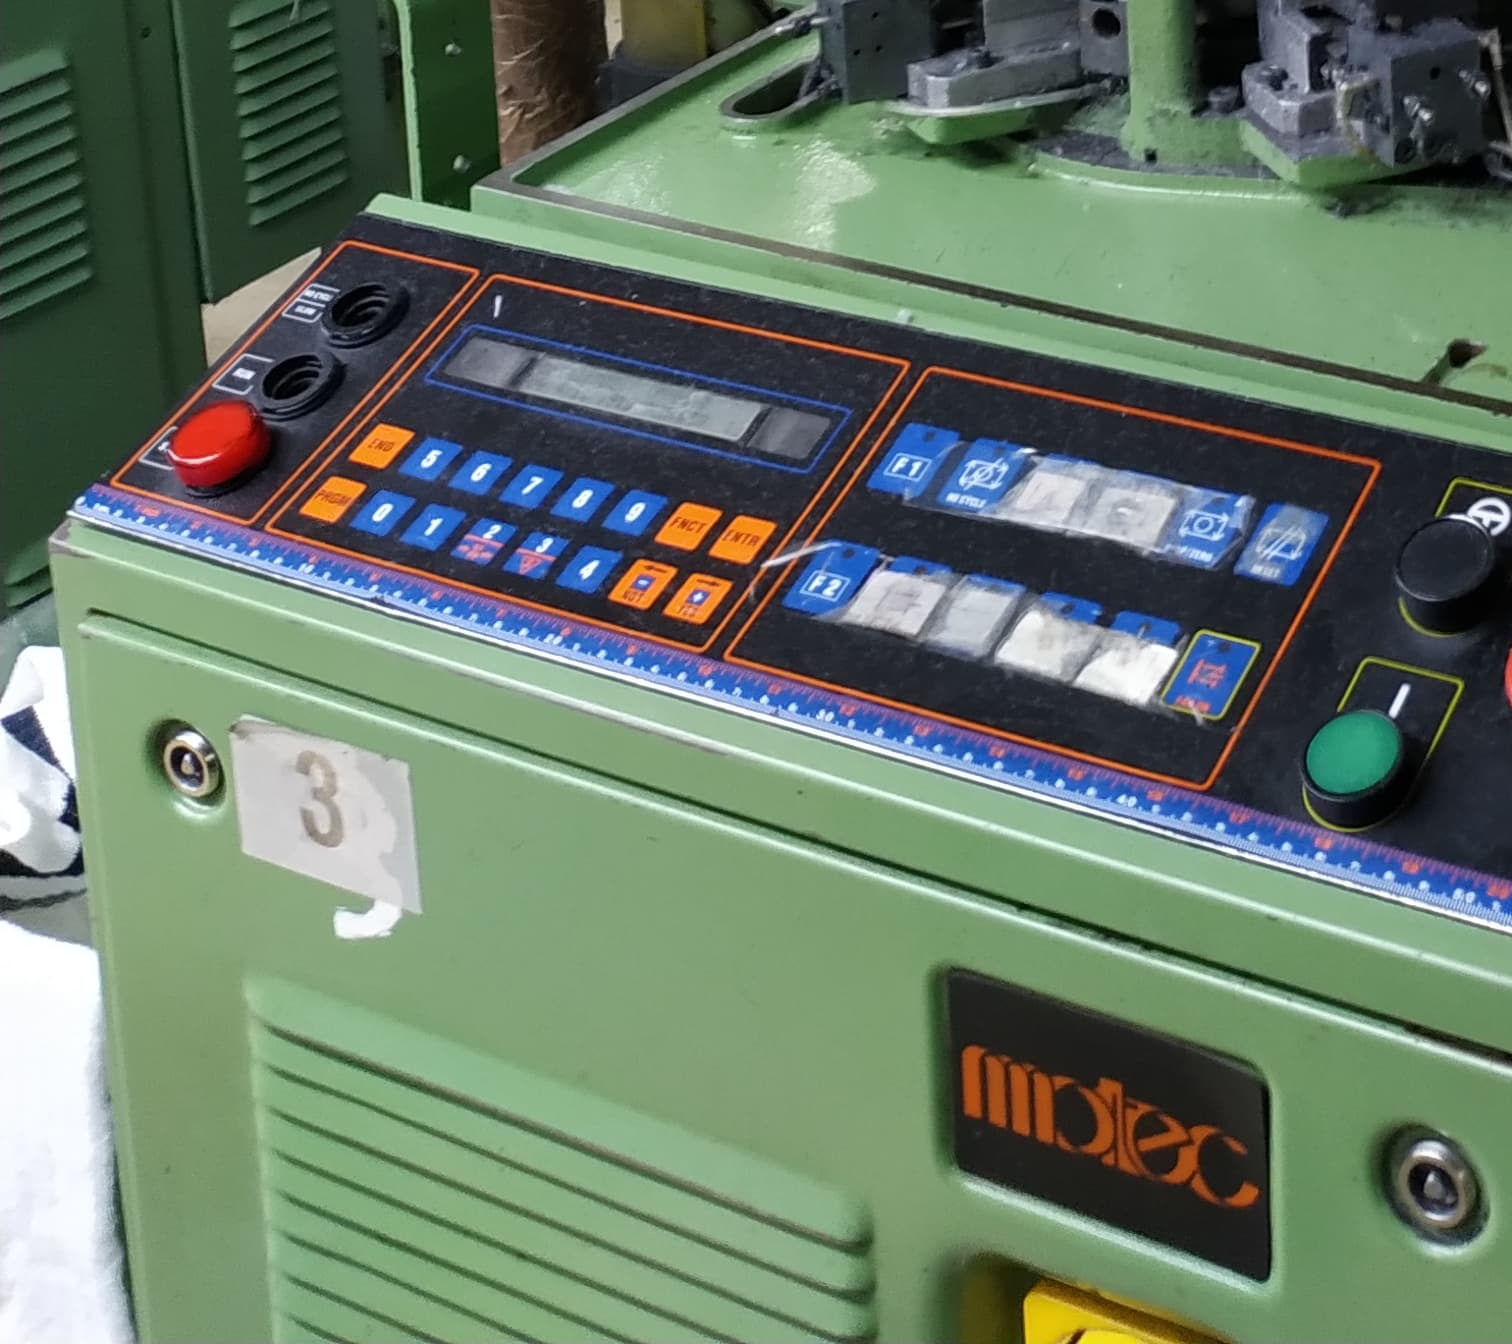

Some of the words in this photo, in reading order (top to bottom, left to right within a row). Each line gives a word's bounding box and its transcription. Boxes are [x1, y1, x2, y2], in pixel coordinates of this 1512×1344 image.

[367, 438, 395, 453] END
[420, 448, 443, 469] 5
[891, 457, 924, 478] F1
[469, 463, 493, 483] 6
[521, 476, 544, 496] 7
[571, 489, 594, 509] 8
[371, 502, 395, 523] 0
[623, 502, 647, 524] 9
[423, 516, 444, 537] 1
[482, 524, 503, 540] 2
[668, 515, 709, 534] FNCT
[535, 537, 555, 553] 3
[721, 529, 761, 548] ENTR
[578, 559, 601, 581] 4
[806, 576, 843, 598] F2
[295, 750, 345, 849] 3
